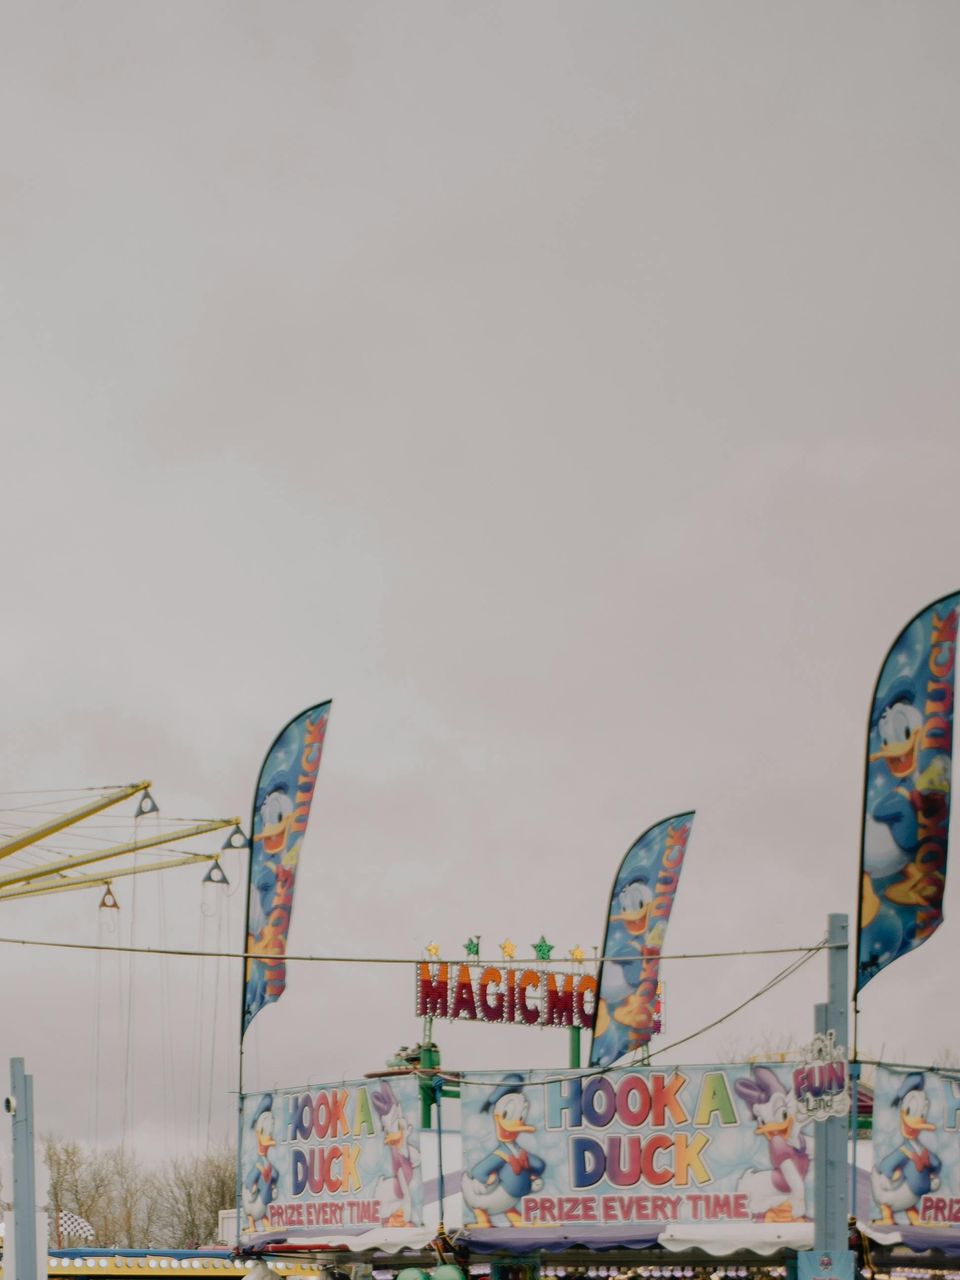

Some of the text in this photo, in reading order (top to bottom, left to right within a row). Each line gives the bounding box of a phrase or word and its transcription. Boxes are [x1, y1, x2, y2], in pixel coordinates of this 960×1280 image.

[921, 608, 958, 752] DUCK
[653, 824, 689, 918] DUCK
[416, 962, 541, 1026] MAGIC
[545, 1073, 738, 1129] HOOK A
[793, 1061, 845, 1098] FUN
[806, 1096, 833, 1112] Land
[283, 1086, 376, 1141] HOOK A
[292, 1143, 362, 1197] DUCK
[571, 1132, 712, 1189] DUCK
[269, 1200, 382, 1227] PRIZE EVERY TIME
[523, 1193, 750, 1223] PRIZE EVERY TIME
